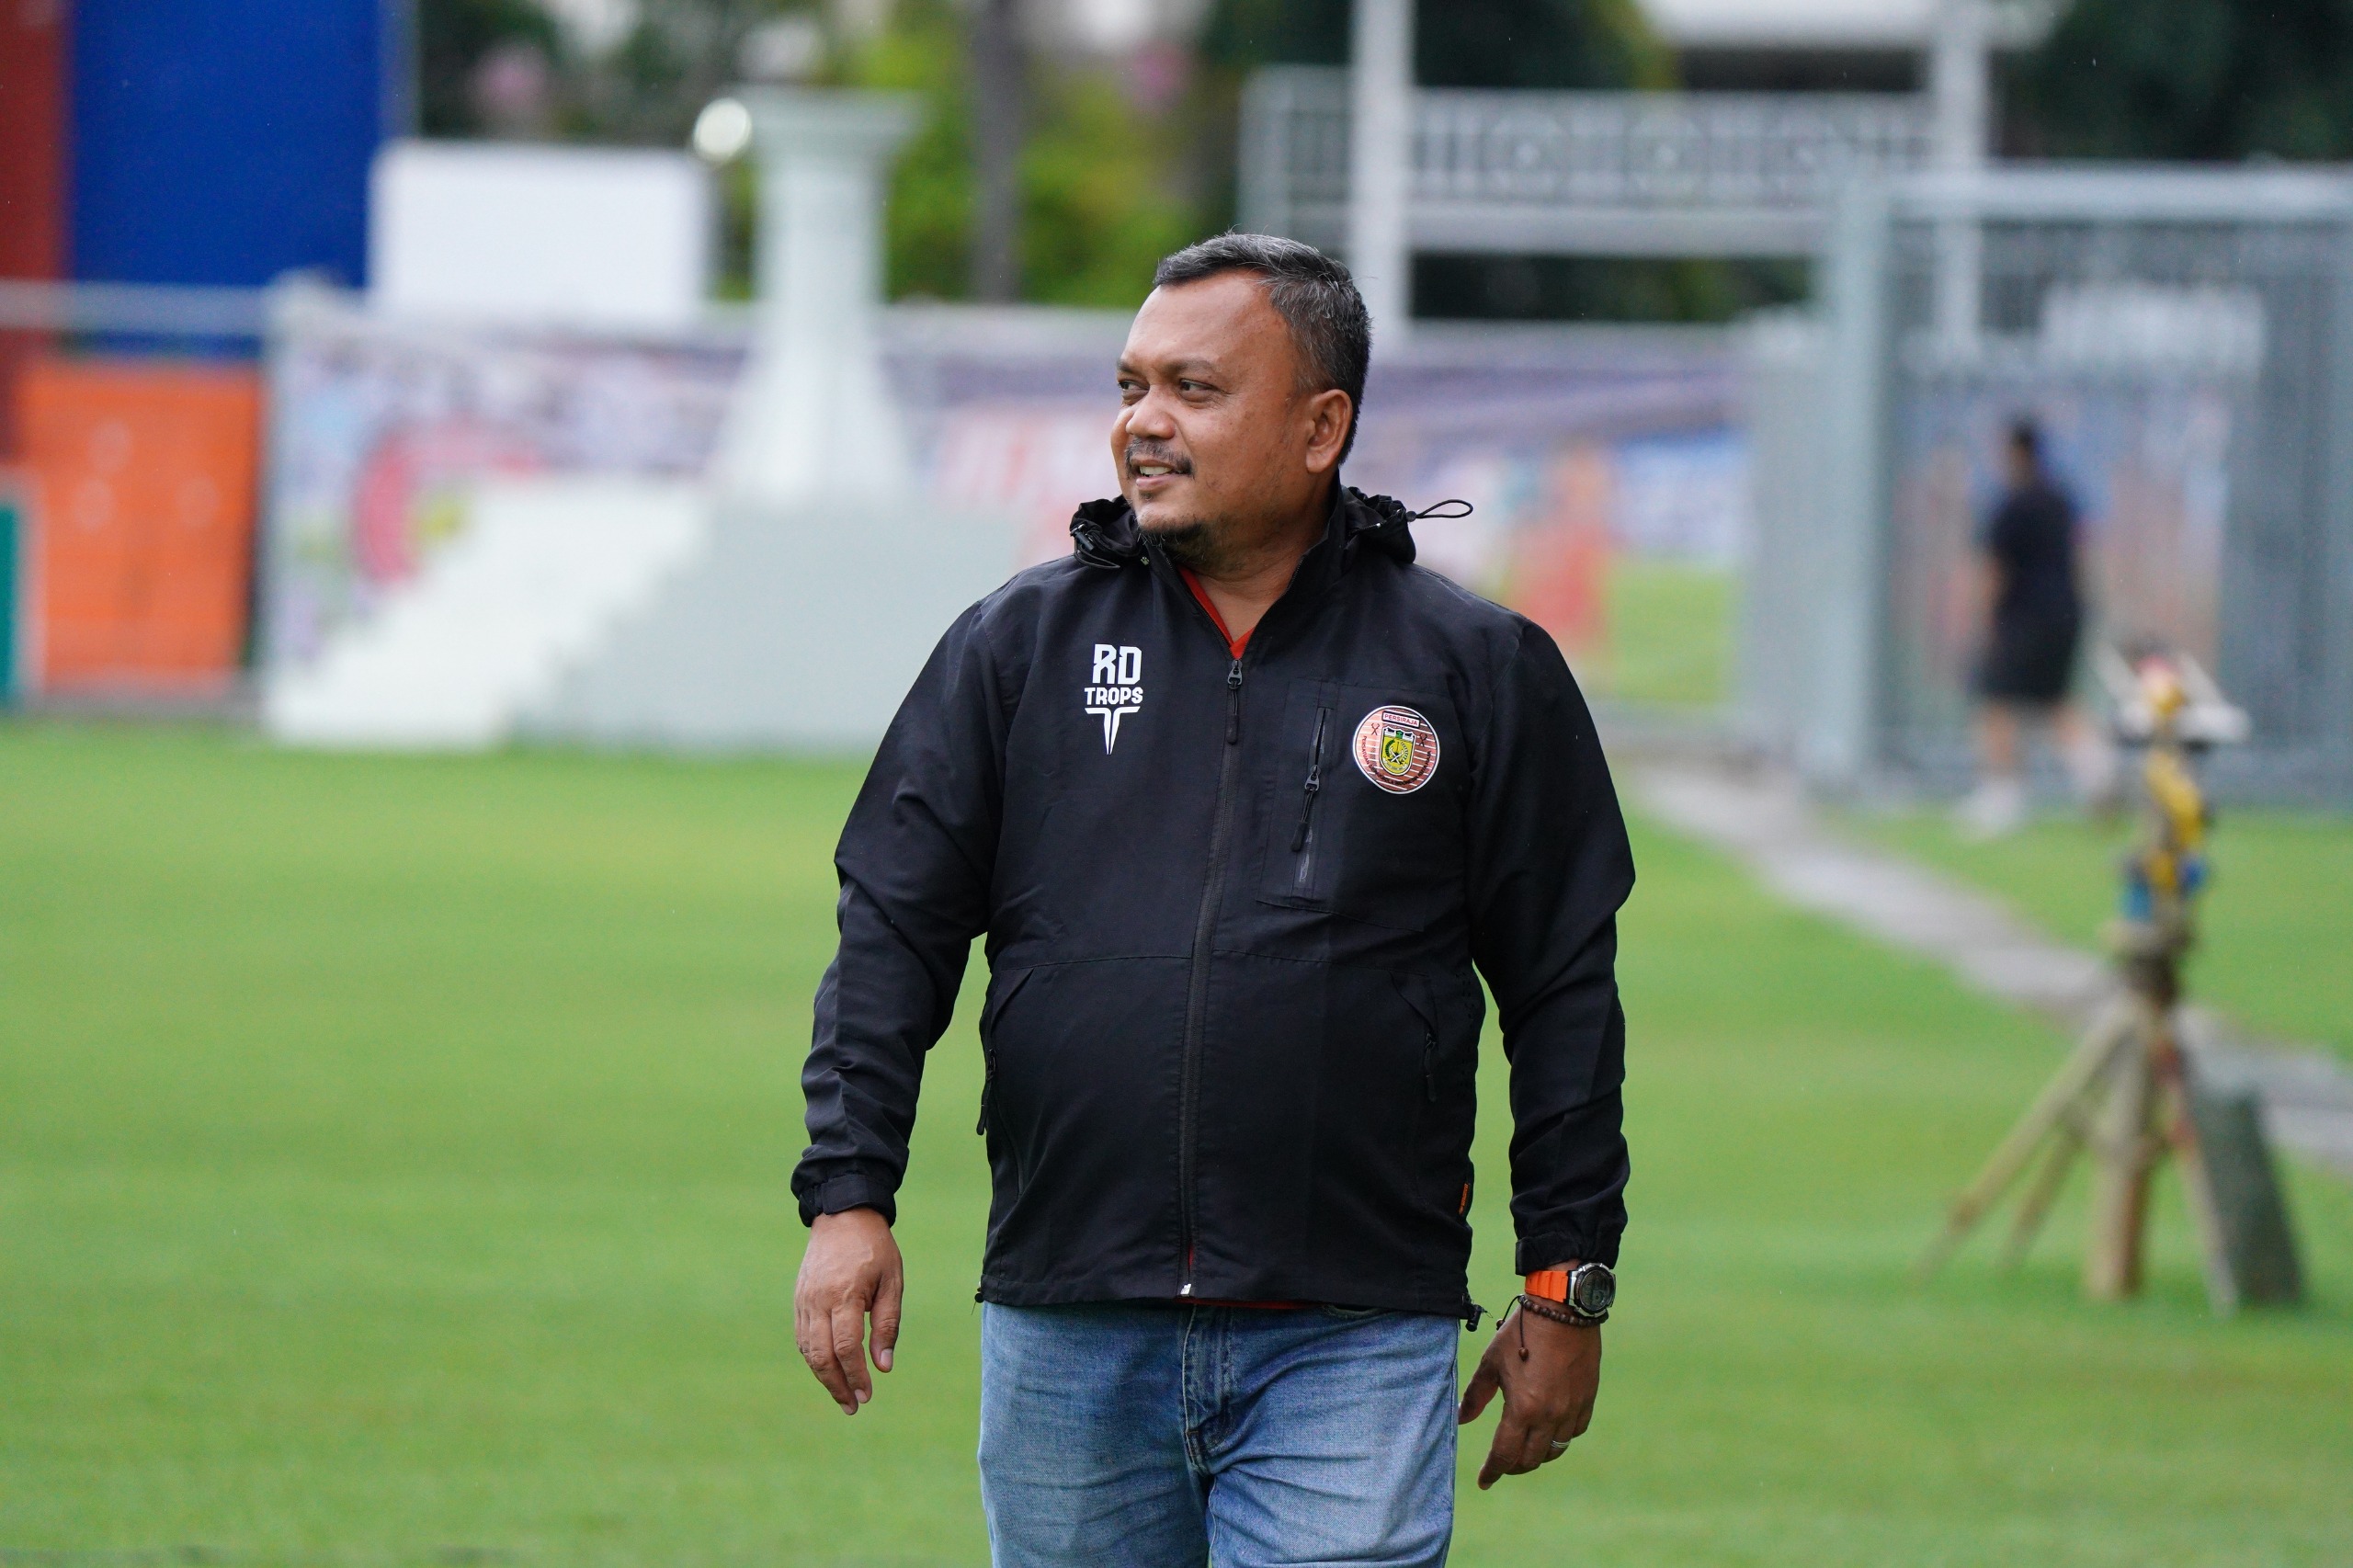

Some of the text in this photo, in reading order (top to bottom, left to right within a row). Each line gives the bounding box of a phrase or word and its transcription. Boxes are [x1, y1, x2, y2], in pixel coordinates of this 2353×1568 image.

[1092, 643, 1142, 685] RD
[1084, 687, 1143, 705] TROPS
[1384, 713, 1418, 726] PERSIRAJA
